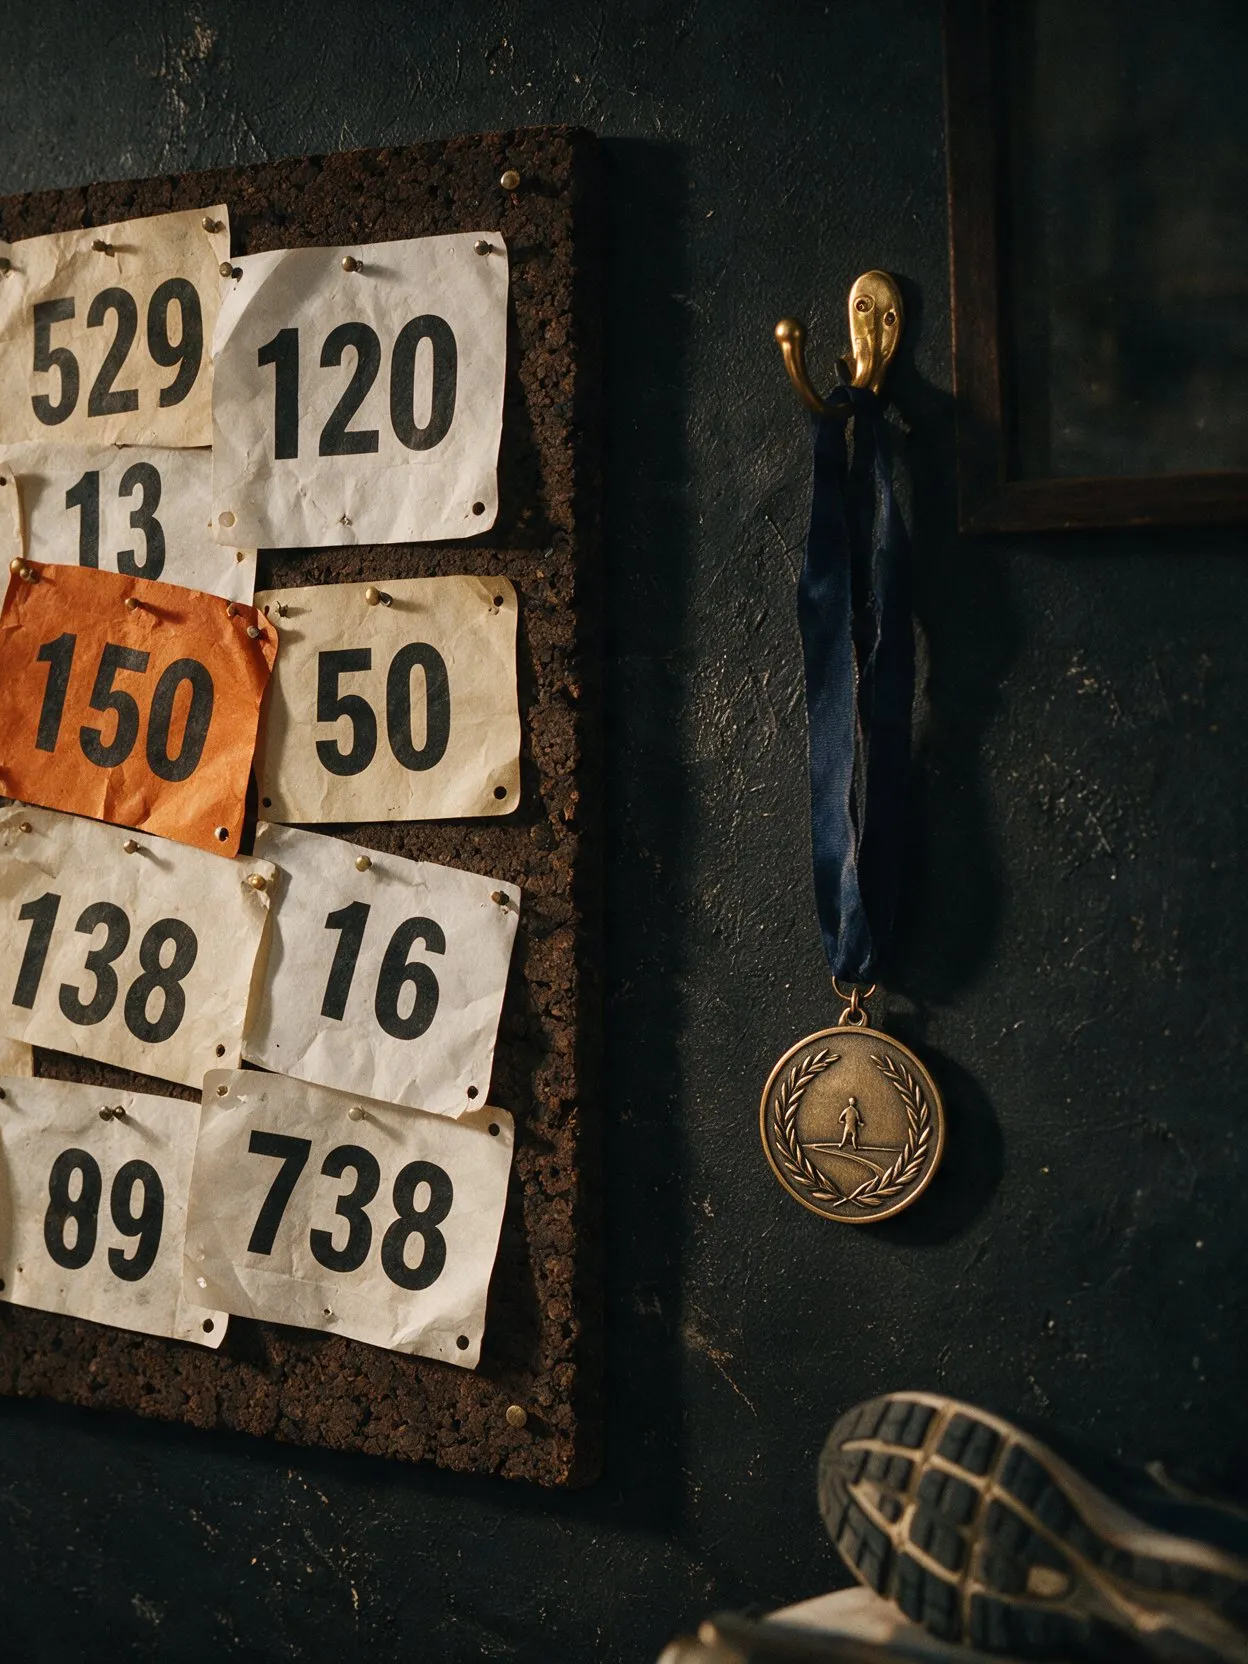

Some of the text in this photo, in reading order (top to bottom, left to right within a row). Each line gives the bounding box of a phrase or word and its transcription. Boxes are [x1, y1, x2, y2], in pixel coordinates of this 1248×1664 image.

[31, 276, 204, 426] 529
[257, 313, 458, 460] 120
[64, 461, 167, 580] 13
[34, 631, 215, 783] 150
[315, 641, 451, 777] 50
[11, 891, 199, 1044] 138
[320, 900, 447, 1041] 16
[43, 1147, 165, 1282] 89
[246, 1129, 454, 1291] 738
